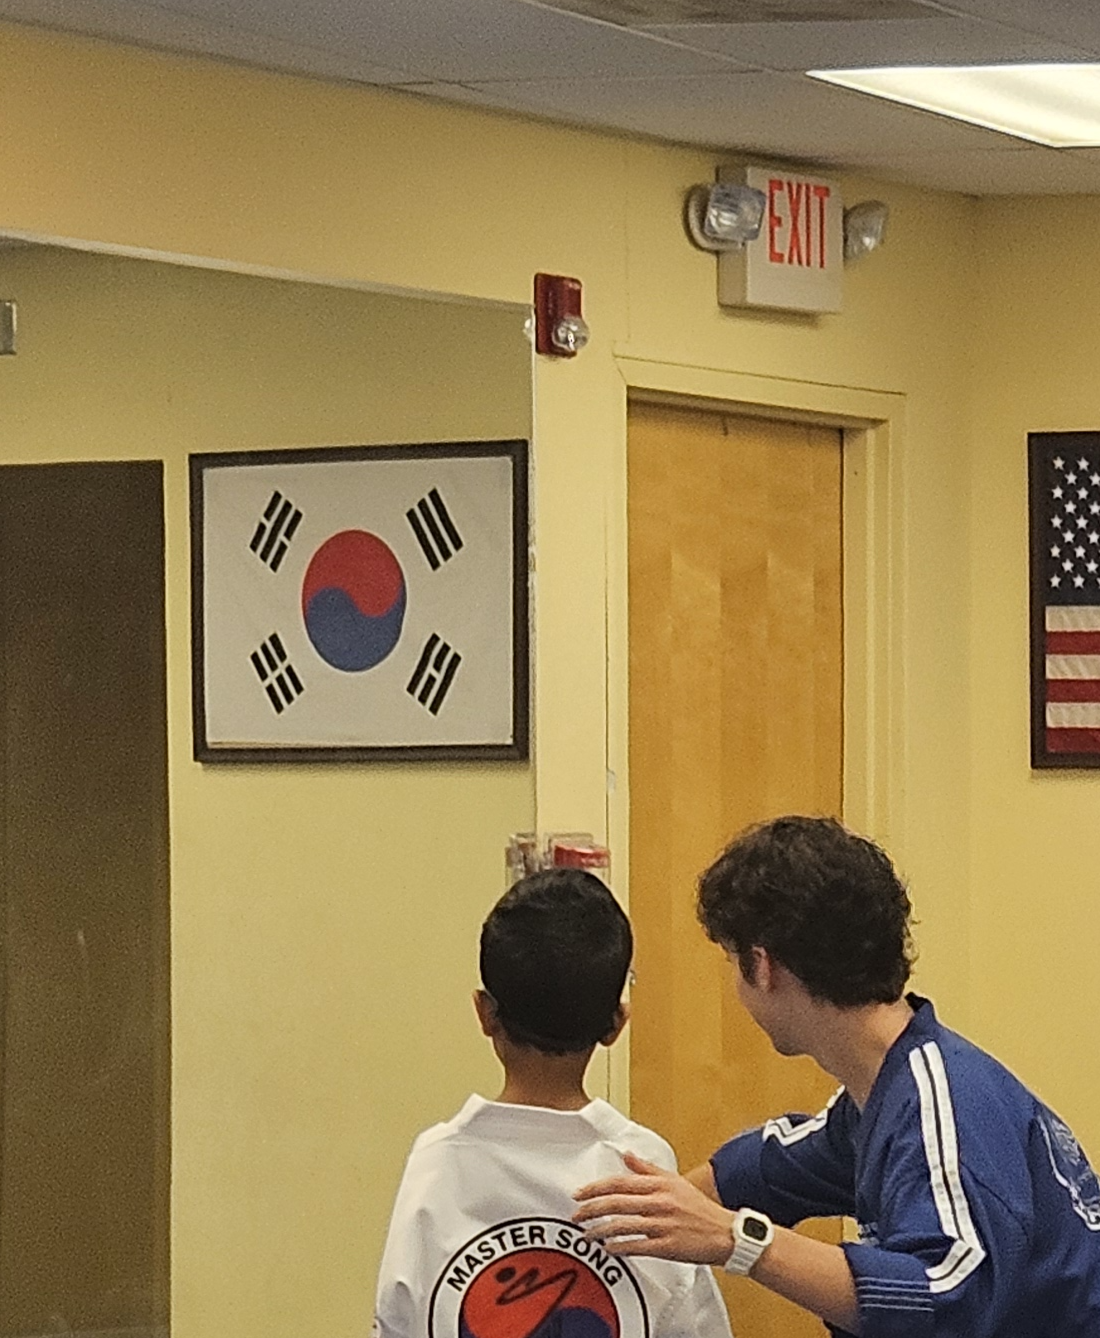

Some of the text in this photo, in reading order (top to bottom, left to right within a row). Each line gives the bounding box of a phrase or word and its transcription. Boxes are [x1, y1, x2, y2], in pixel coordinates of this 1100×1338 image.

[769, 179, 830, 269] EXIT
[447, 1225, 623, 1292] MASTER SONG
